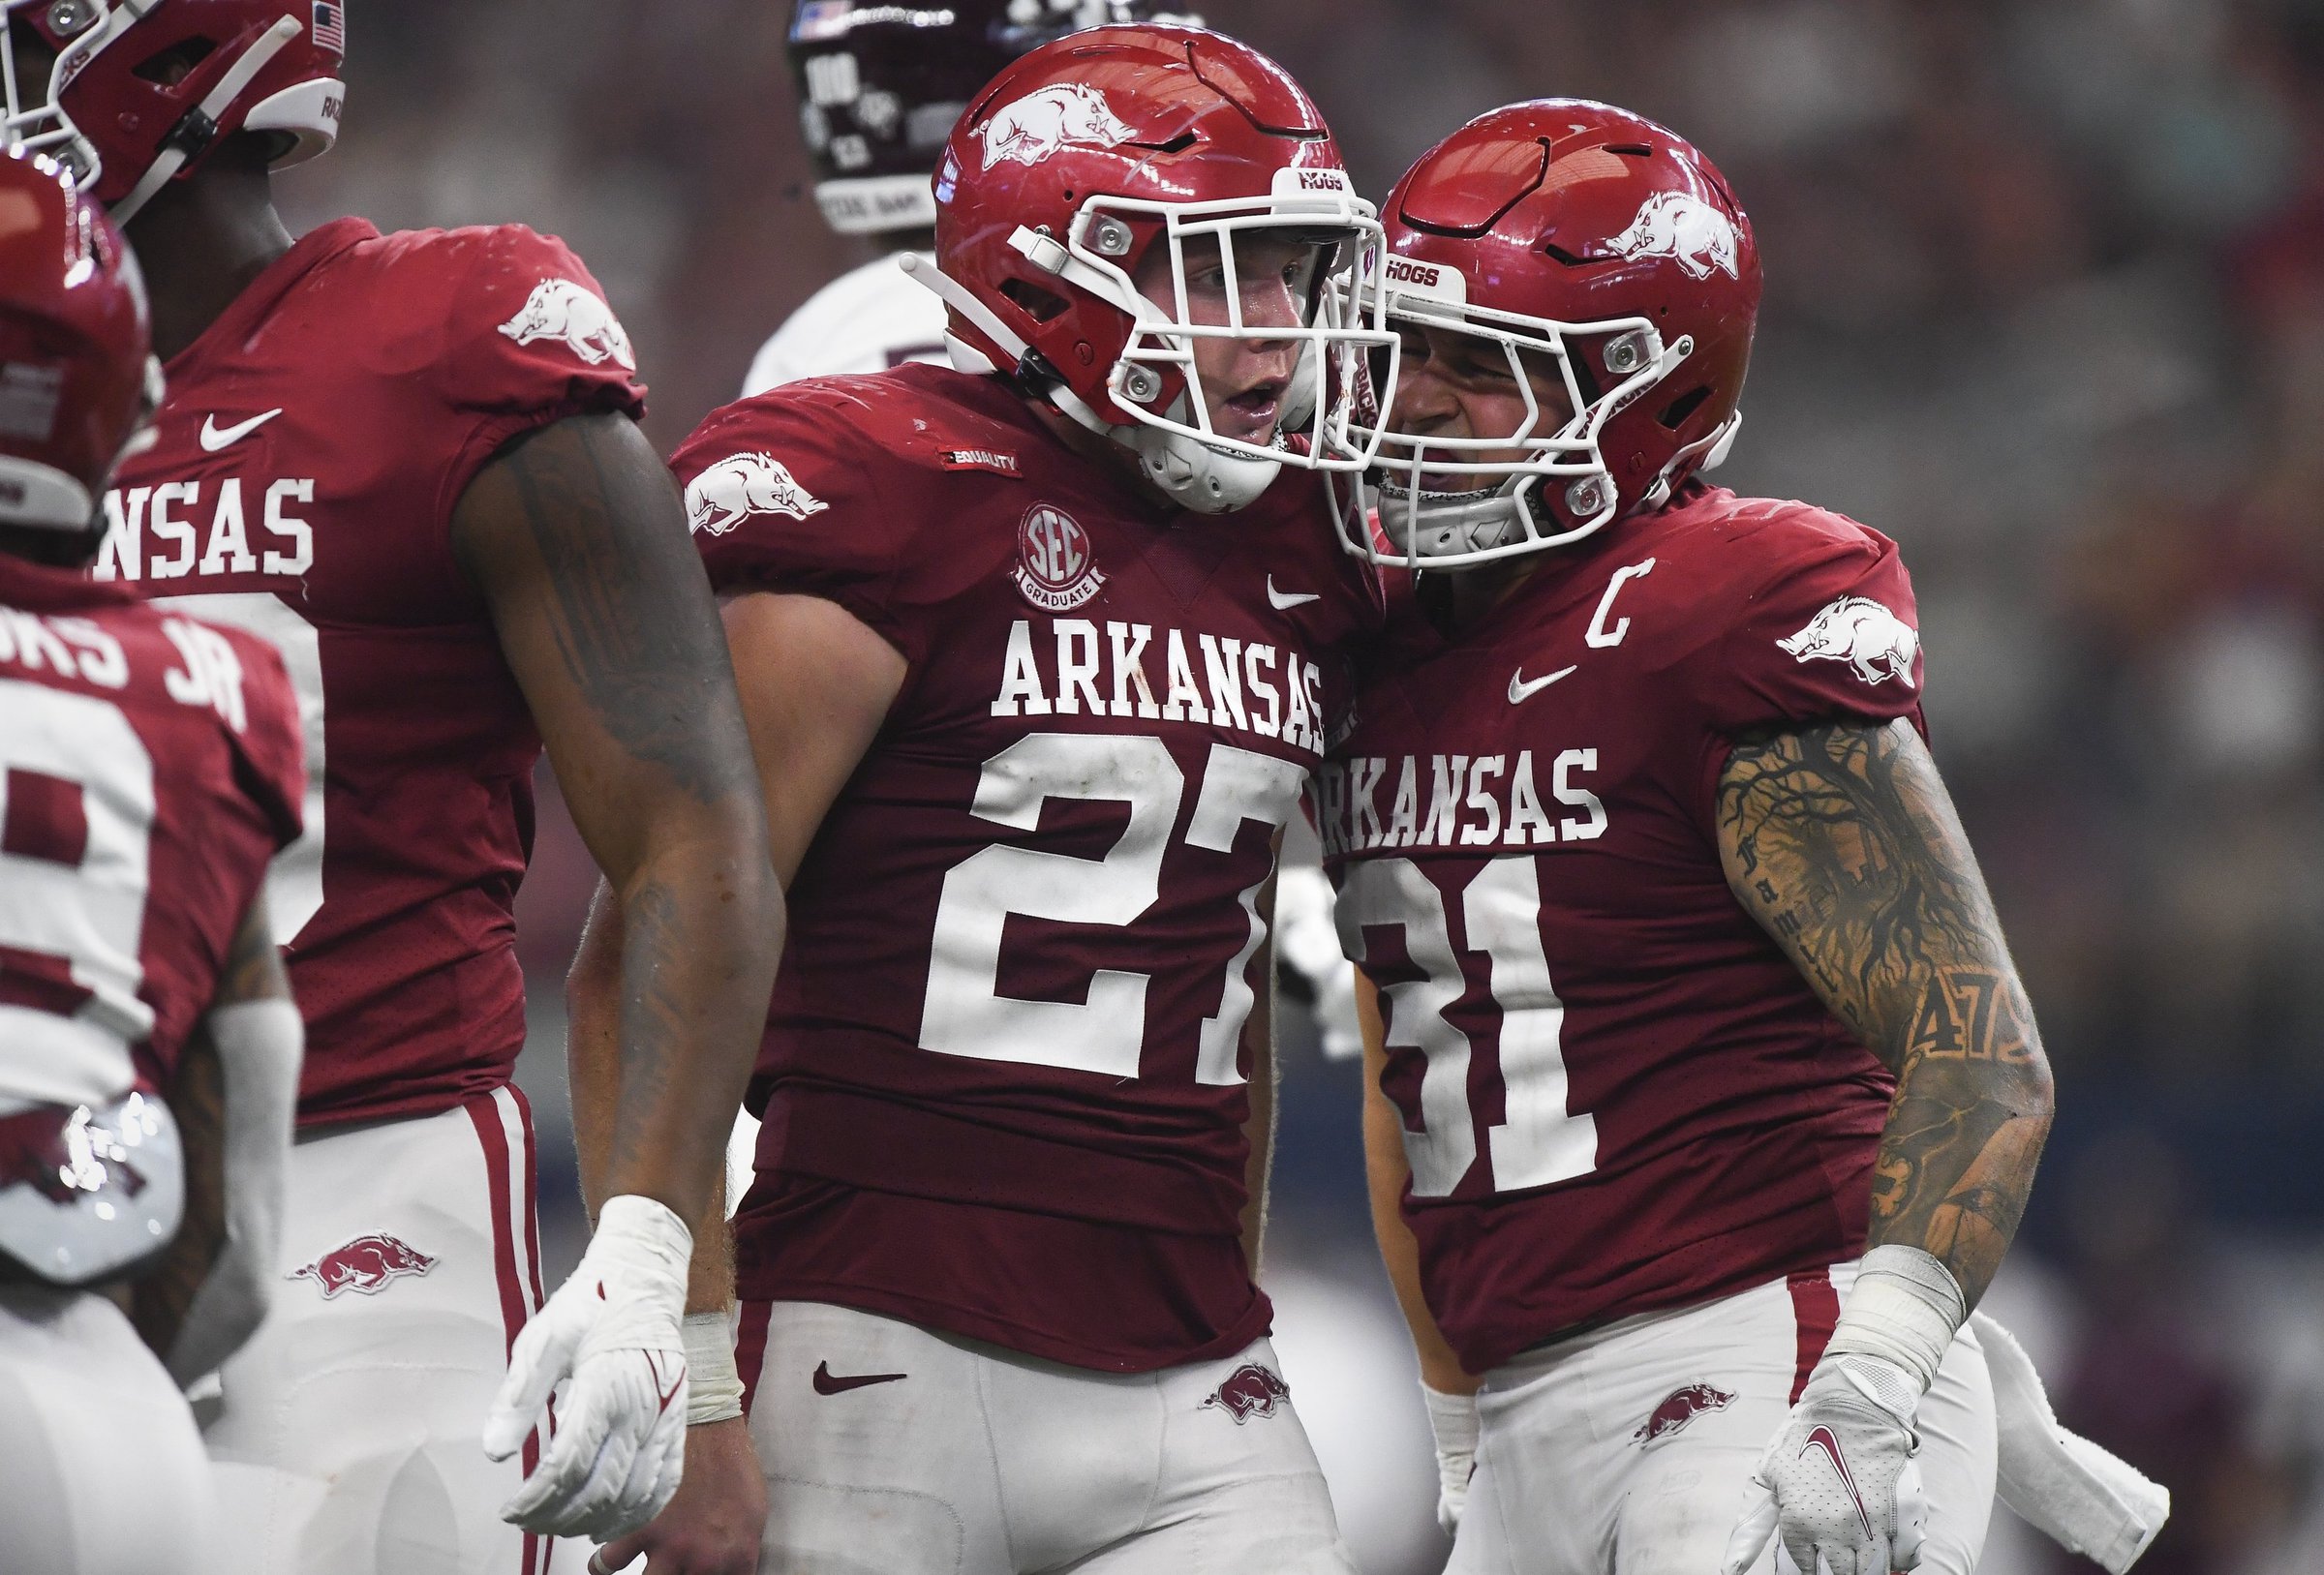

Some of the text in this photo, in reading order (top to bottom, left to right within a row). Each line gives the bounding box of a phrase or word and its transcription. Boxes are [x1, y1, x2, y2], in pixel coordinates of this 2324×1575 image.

[1386, 259, 1440, 287] HOGS
[952, 450, 1016, 470] EQUALITY
[1027, 509, 1083, 581] SEC
[1025, 583, 1092, 607] GRADUATE
[1584, 557, 1656, 649] C
[990, 619, 1325, 758] ARKANSAS
[1307, 748, 1608, 856] RKANSAS
[917, 733, 1310, 1086] 27
[1334, 854, 1598, 1196] 31
